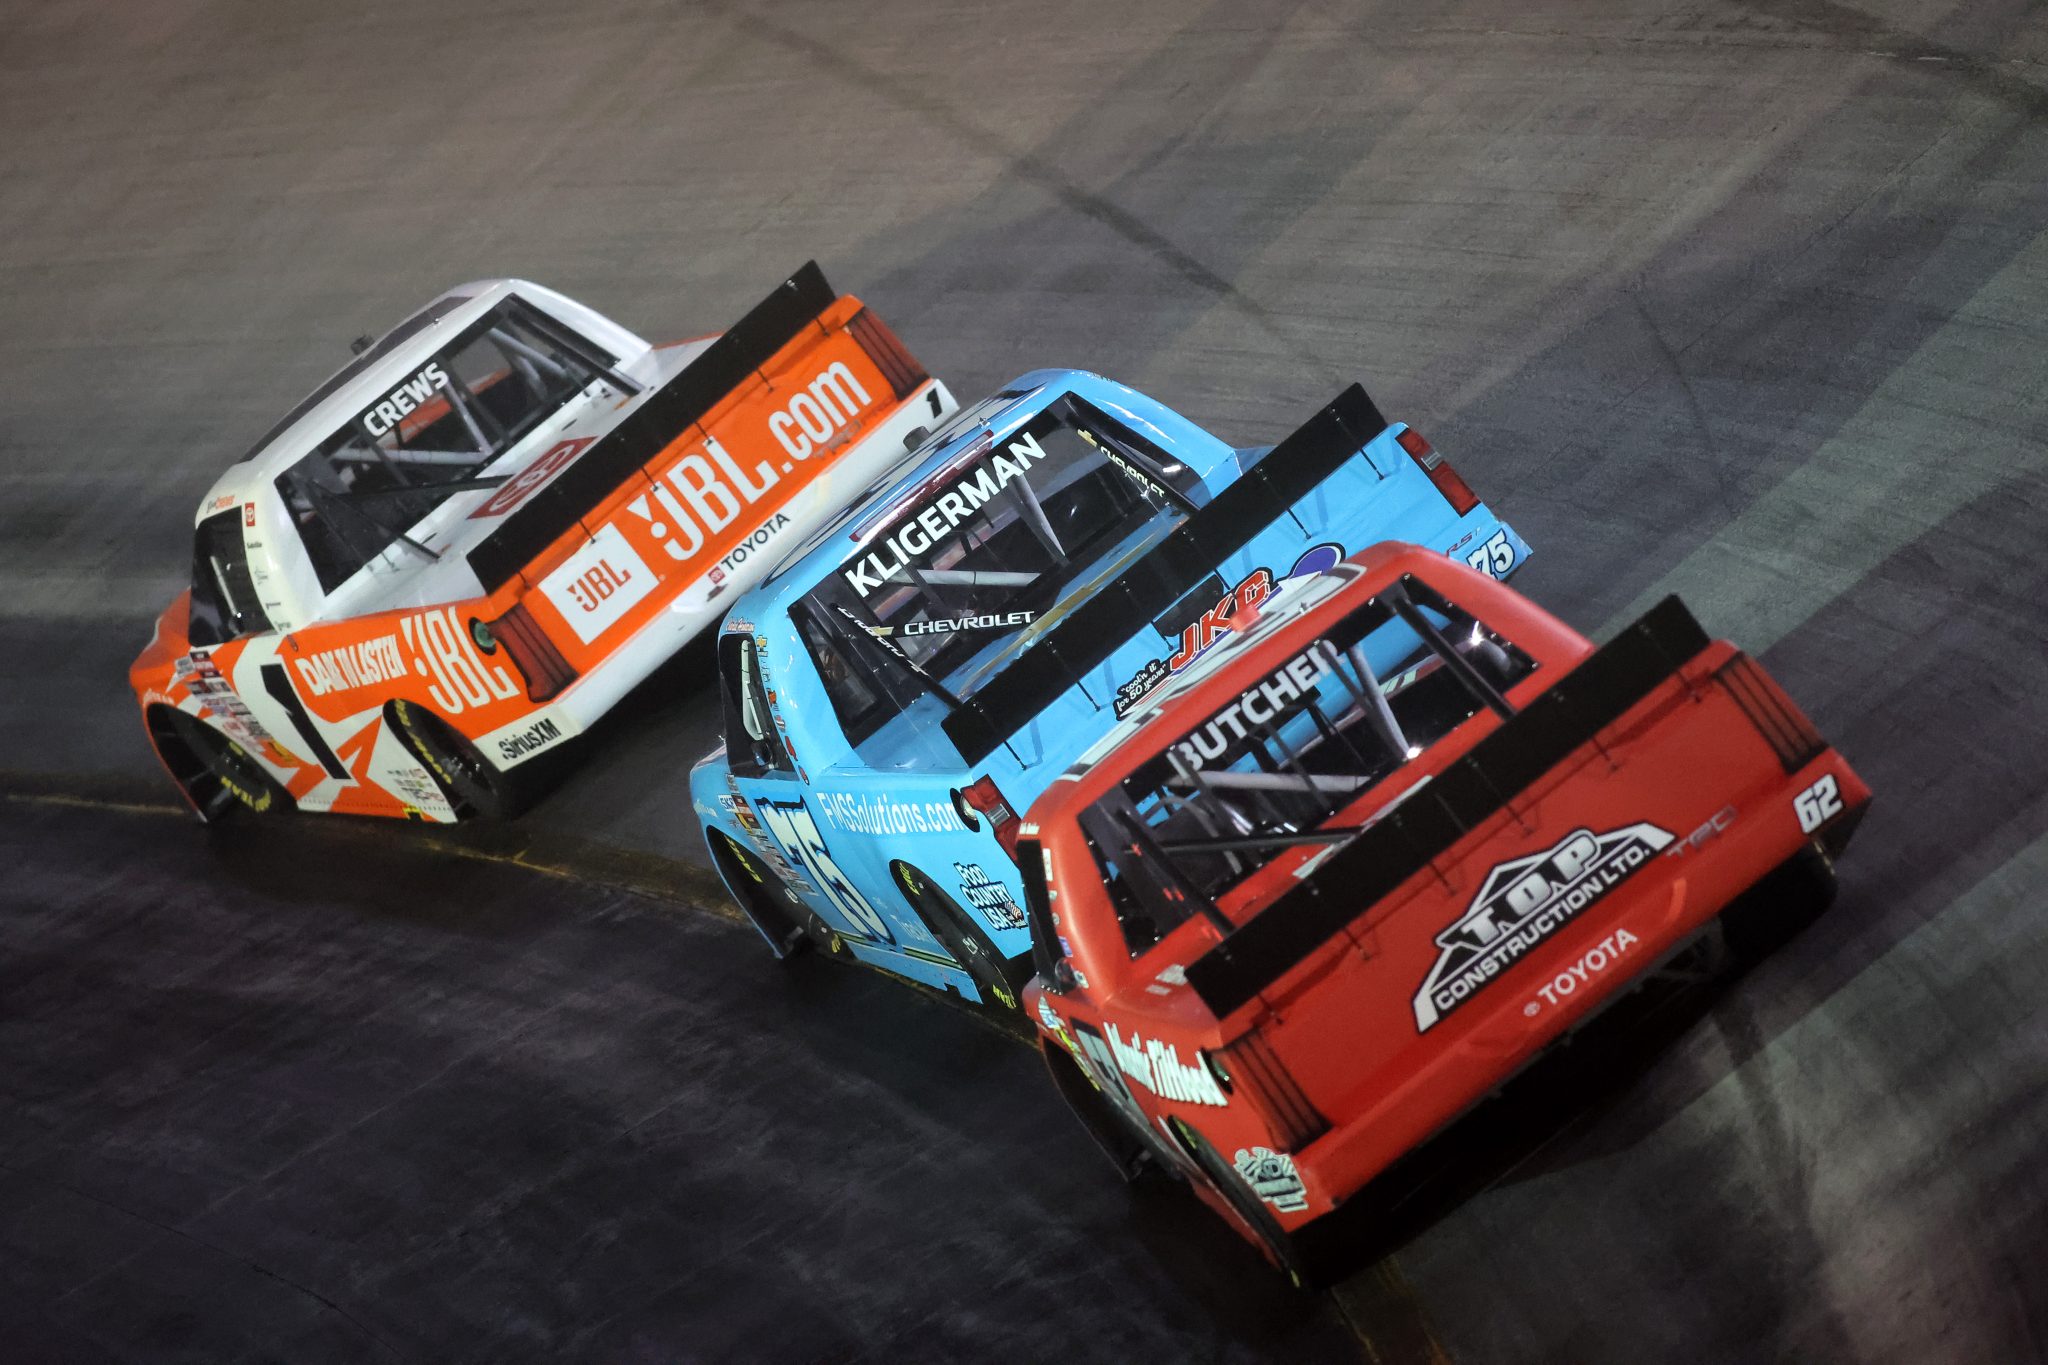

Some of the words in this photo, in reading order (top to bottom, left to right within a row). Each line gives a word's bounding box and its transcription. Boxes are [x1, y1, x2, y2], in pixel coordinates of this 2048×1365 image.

[363, 362, 449, 437] CREWS
[650, 361, 872, 561] JBL.com
[720, 513, 791, 570] TOYOTA
[844, 431, 1046, 598] KLIGERMAN
[1466, 528, 1516, 580] 75
[570, 557, 632, 613] JBL
[904, 610, 1035, 636] CHEVROLET
[408, 605, 521, 714] JBL
[1129, 684, 1143, 700] 50
[1166, 639, 1346, 780] BUTCHER
[498, 717, 562, 763] SiriusXM
[1793, 773, 1844, 834] 62
[754, 796, 897, 945] 75
[953, 862, 991, 888] FOOD
[961, 881, 1015, 908] COUNTRY
[979, 905, 1016, 931] USA
[1436, 874, 1604, 1011] CONSTRUCTION
[1600, 845, 1651, 888] LTD.
[1537, 927, 1639, 1007] TOYOTA
